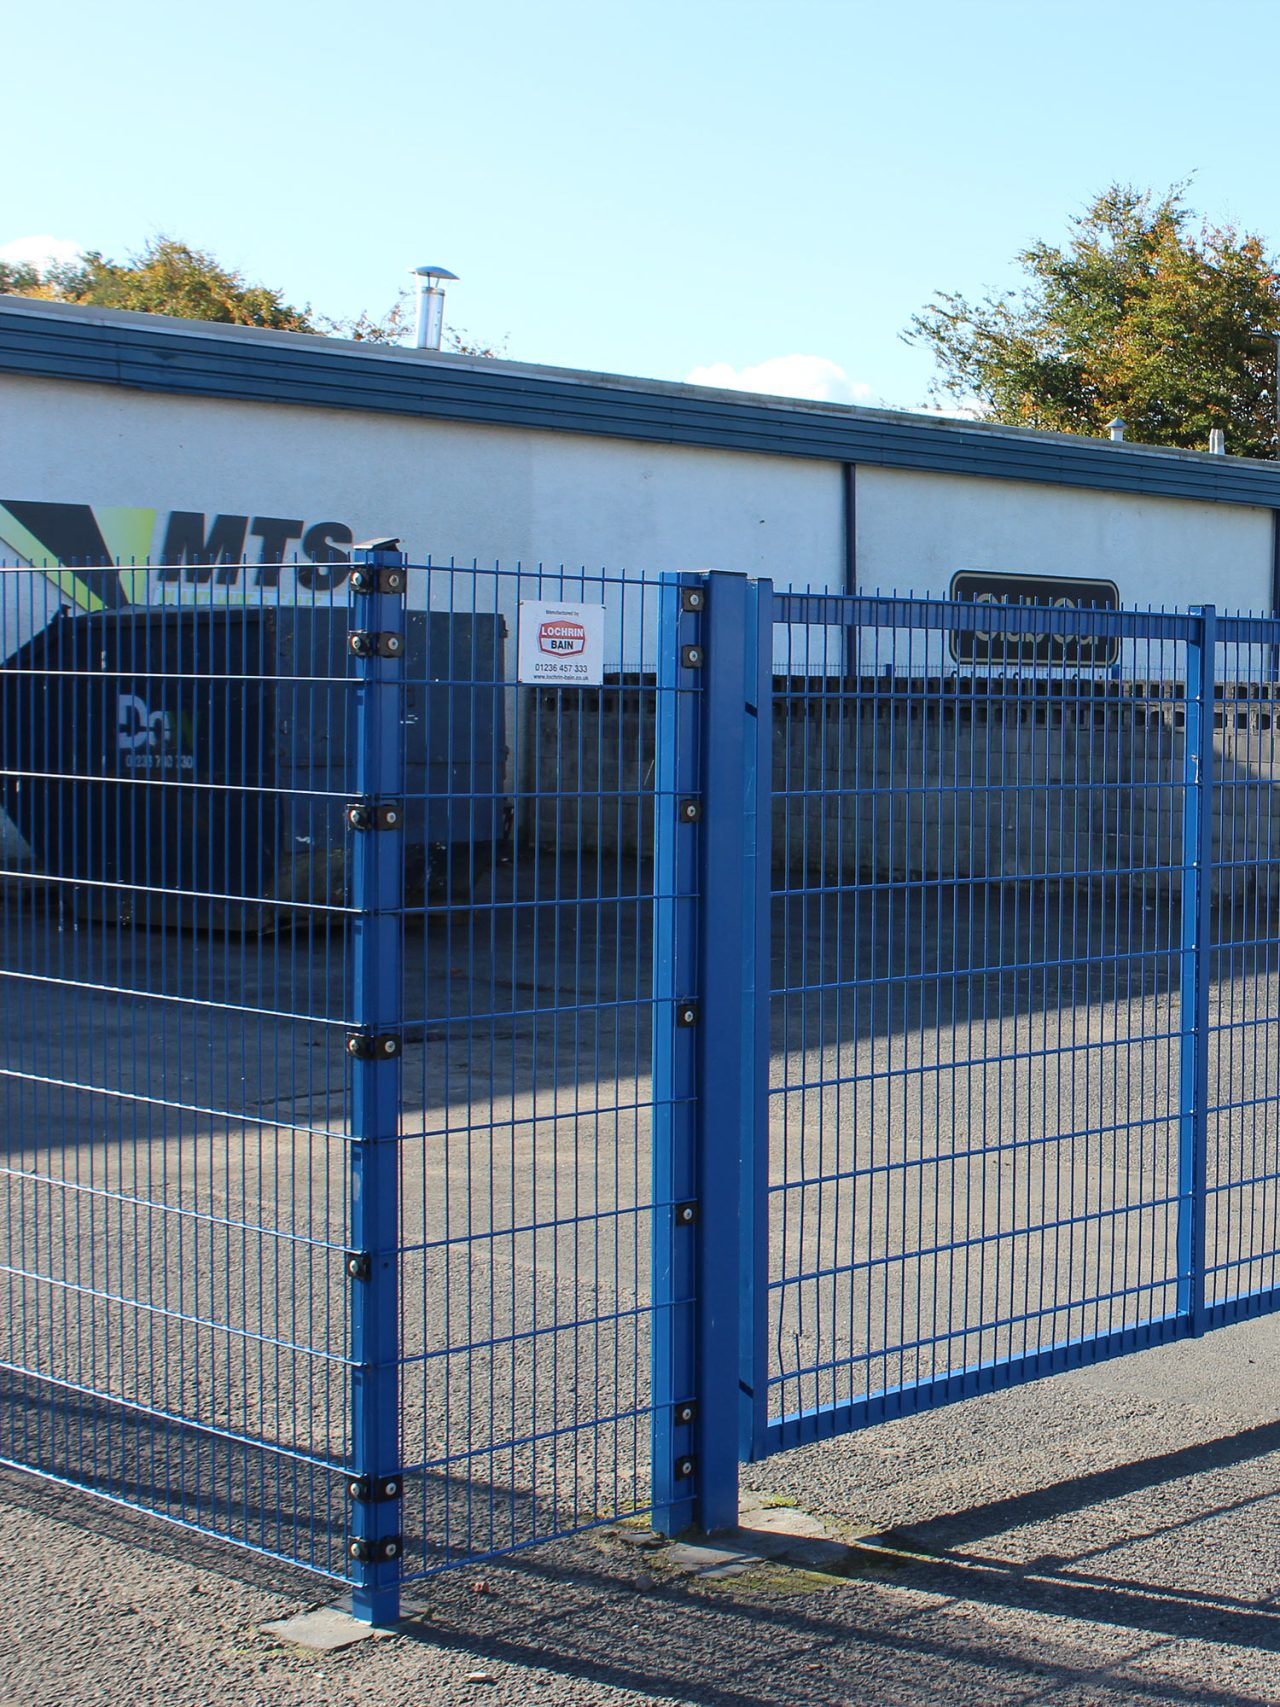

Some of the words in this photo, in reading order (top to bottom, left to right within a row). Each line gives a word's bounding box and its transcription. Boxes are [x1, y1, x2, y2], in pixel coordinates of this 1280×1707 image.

[158, 511, 353, 591] MTS
[541, 627, 583, 637] LOCHRIN
[551, 640, 574, 650] BAIN
[535, 664, 557, 672] 01236
[559, 664, 573, 673] 457
[574, 664, 588, 673] 333
